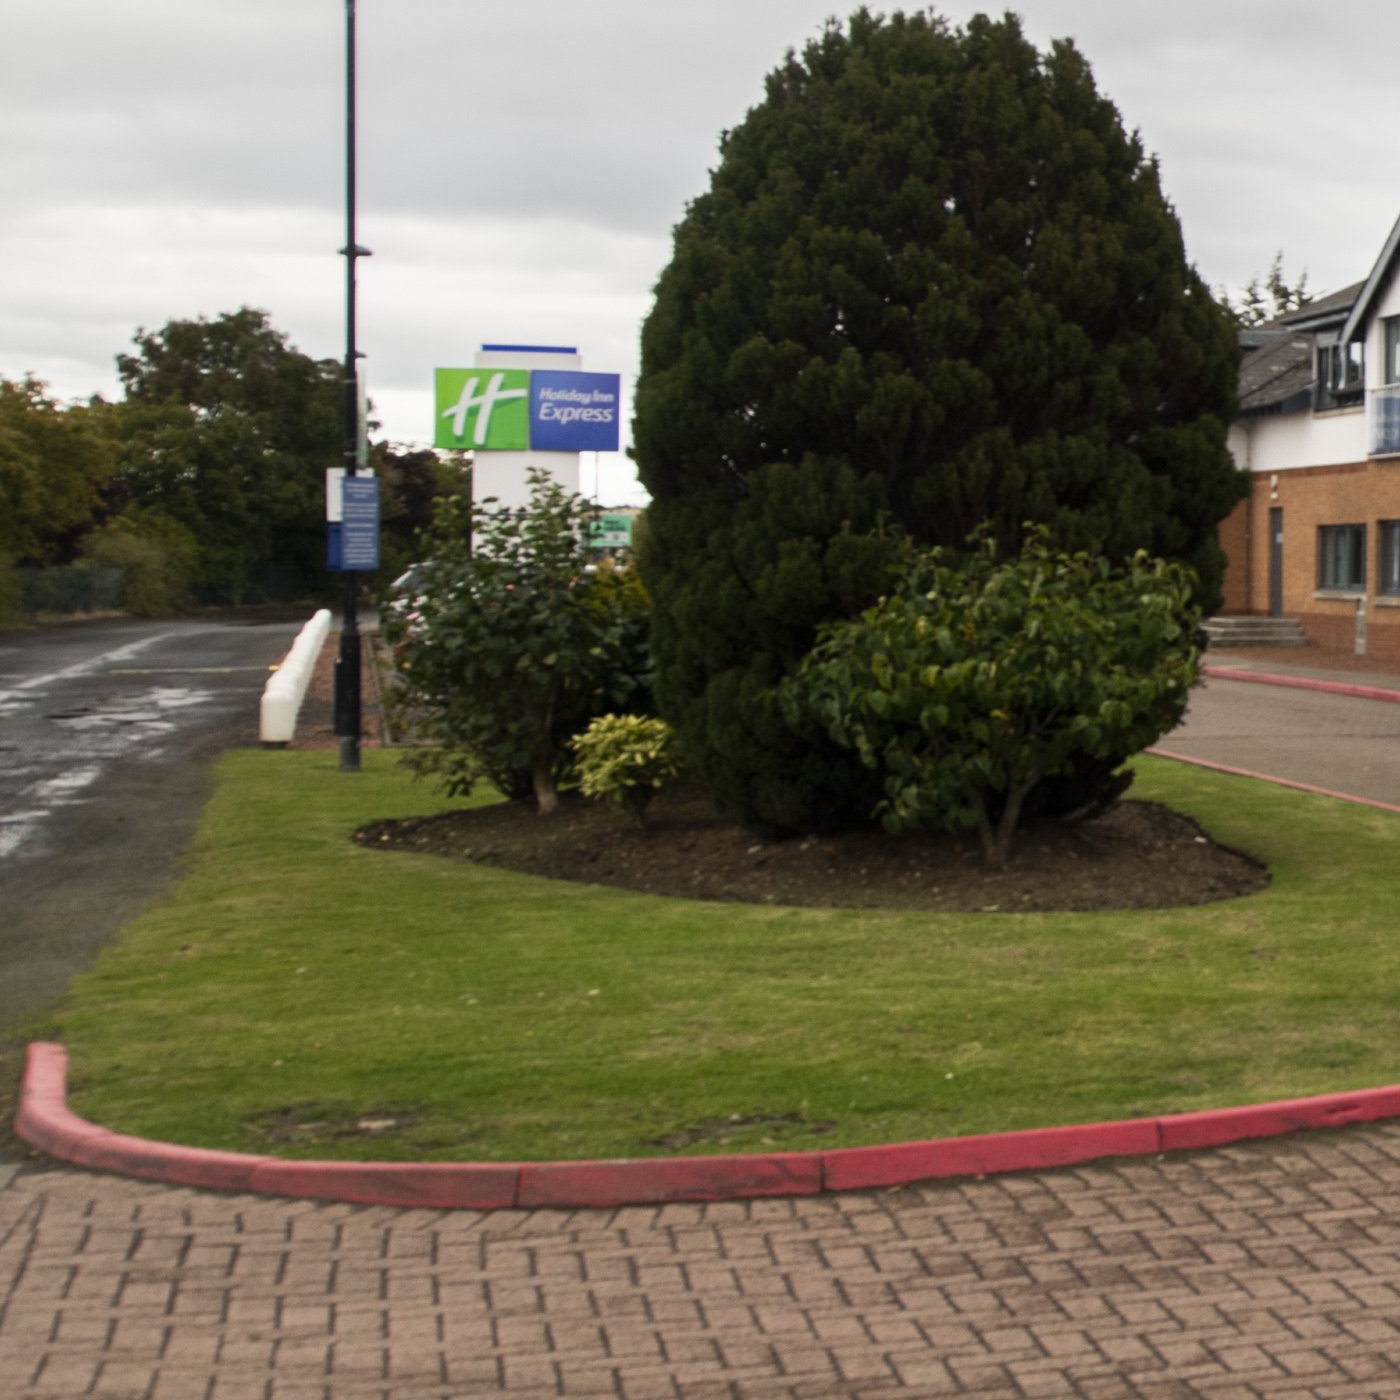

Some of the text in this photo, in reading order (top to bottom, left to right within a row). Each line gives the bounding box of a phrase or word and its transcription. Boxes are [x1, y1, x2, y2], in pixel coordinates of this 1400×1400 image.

[539, 387, 614, 405] Holiday Inn
[441, 373, 528, 445] H
[538, 403, 613, 424] Express
